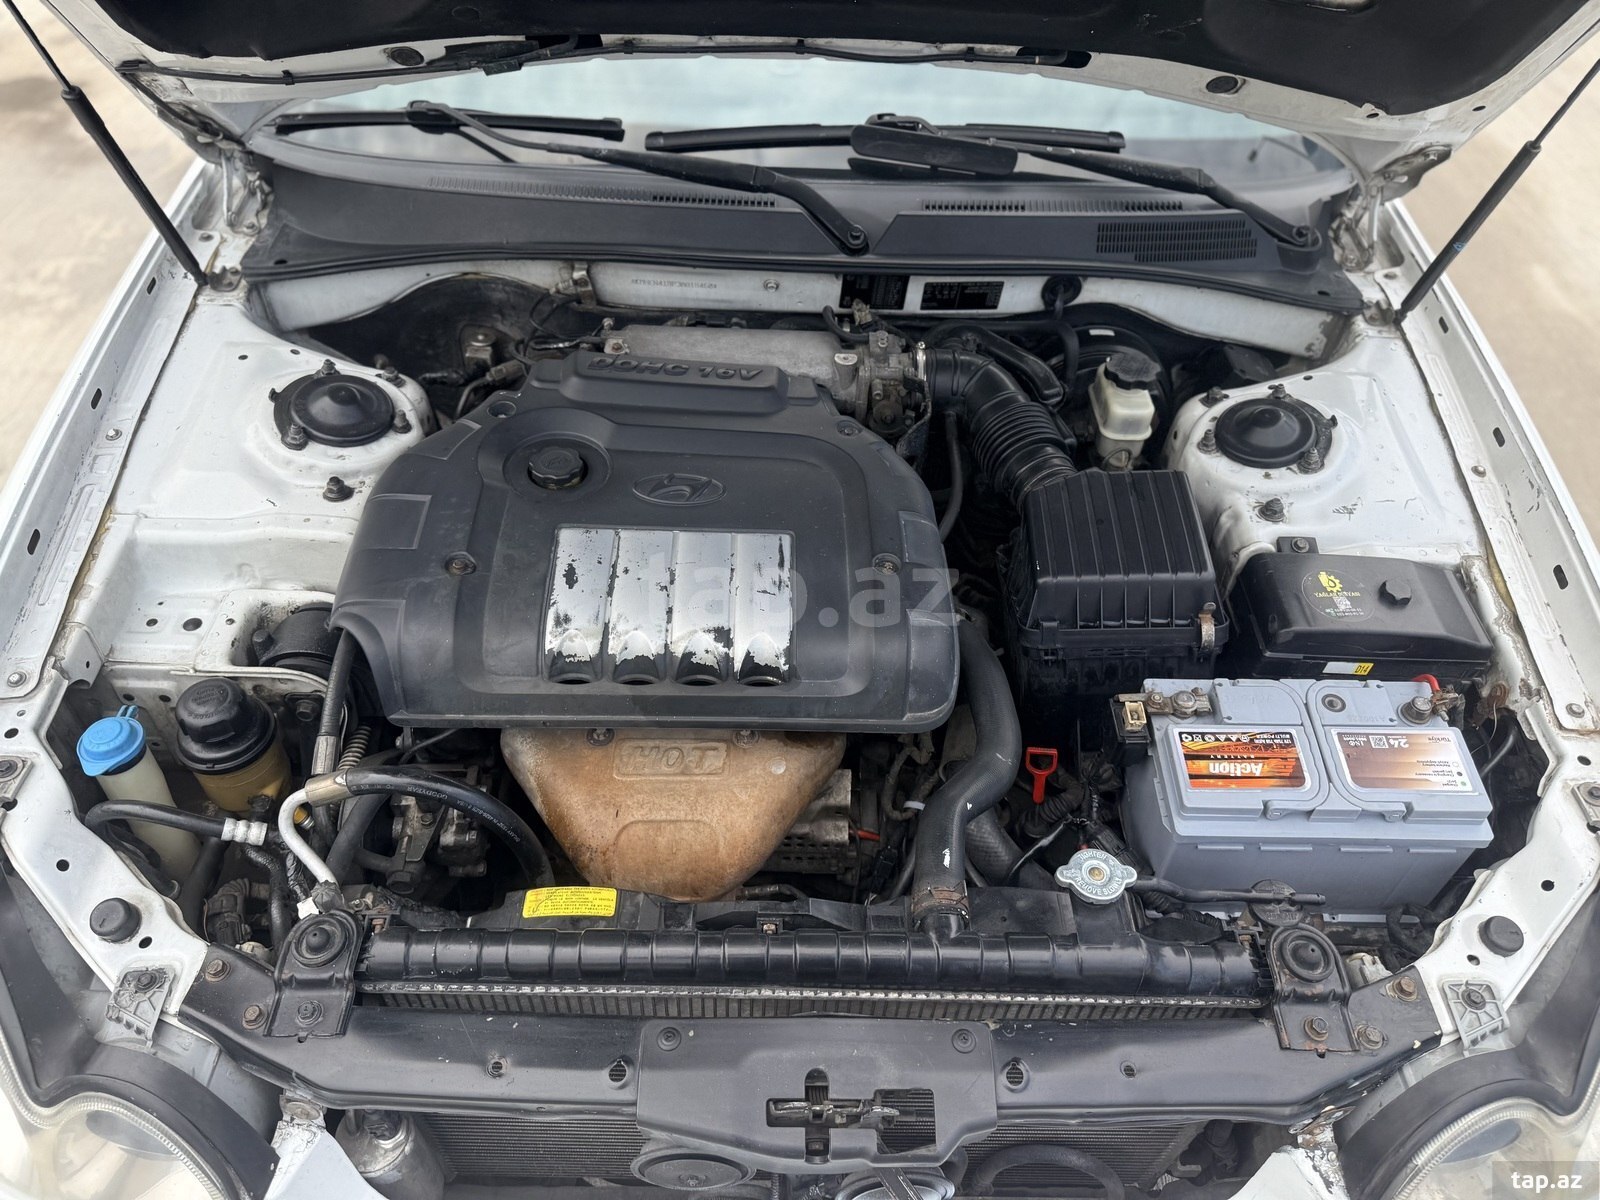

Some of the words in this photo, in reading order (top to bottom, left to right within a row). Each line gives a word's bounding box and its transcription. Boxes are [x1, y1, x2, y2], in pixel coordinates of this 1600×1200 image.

[587, 356, 690, 377] DOHC
[698, 366, 763, 381] 16V
[630, 745, 719, 772] HOT
[1209, 762, 1263, 777] Action
[407, 785, 448, 800] GOODYEAR
[1075, 877, 1102, 895] REMOVE
[1103, 876, 1123, 895] SLOWLY
